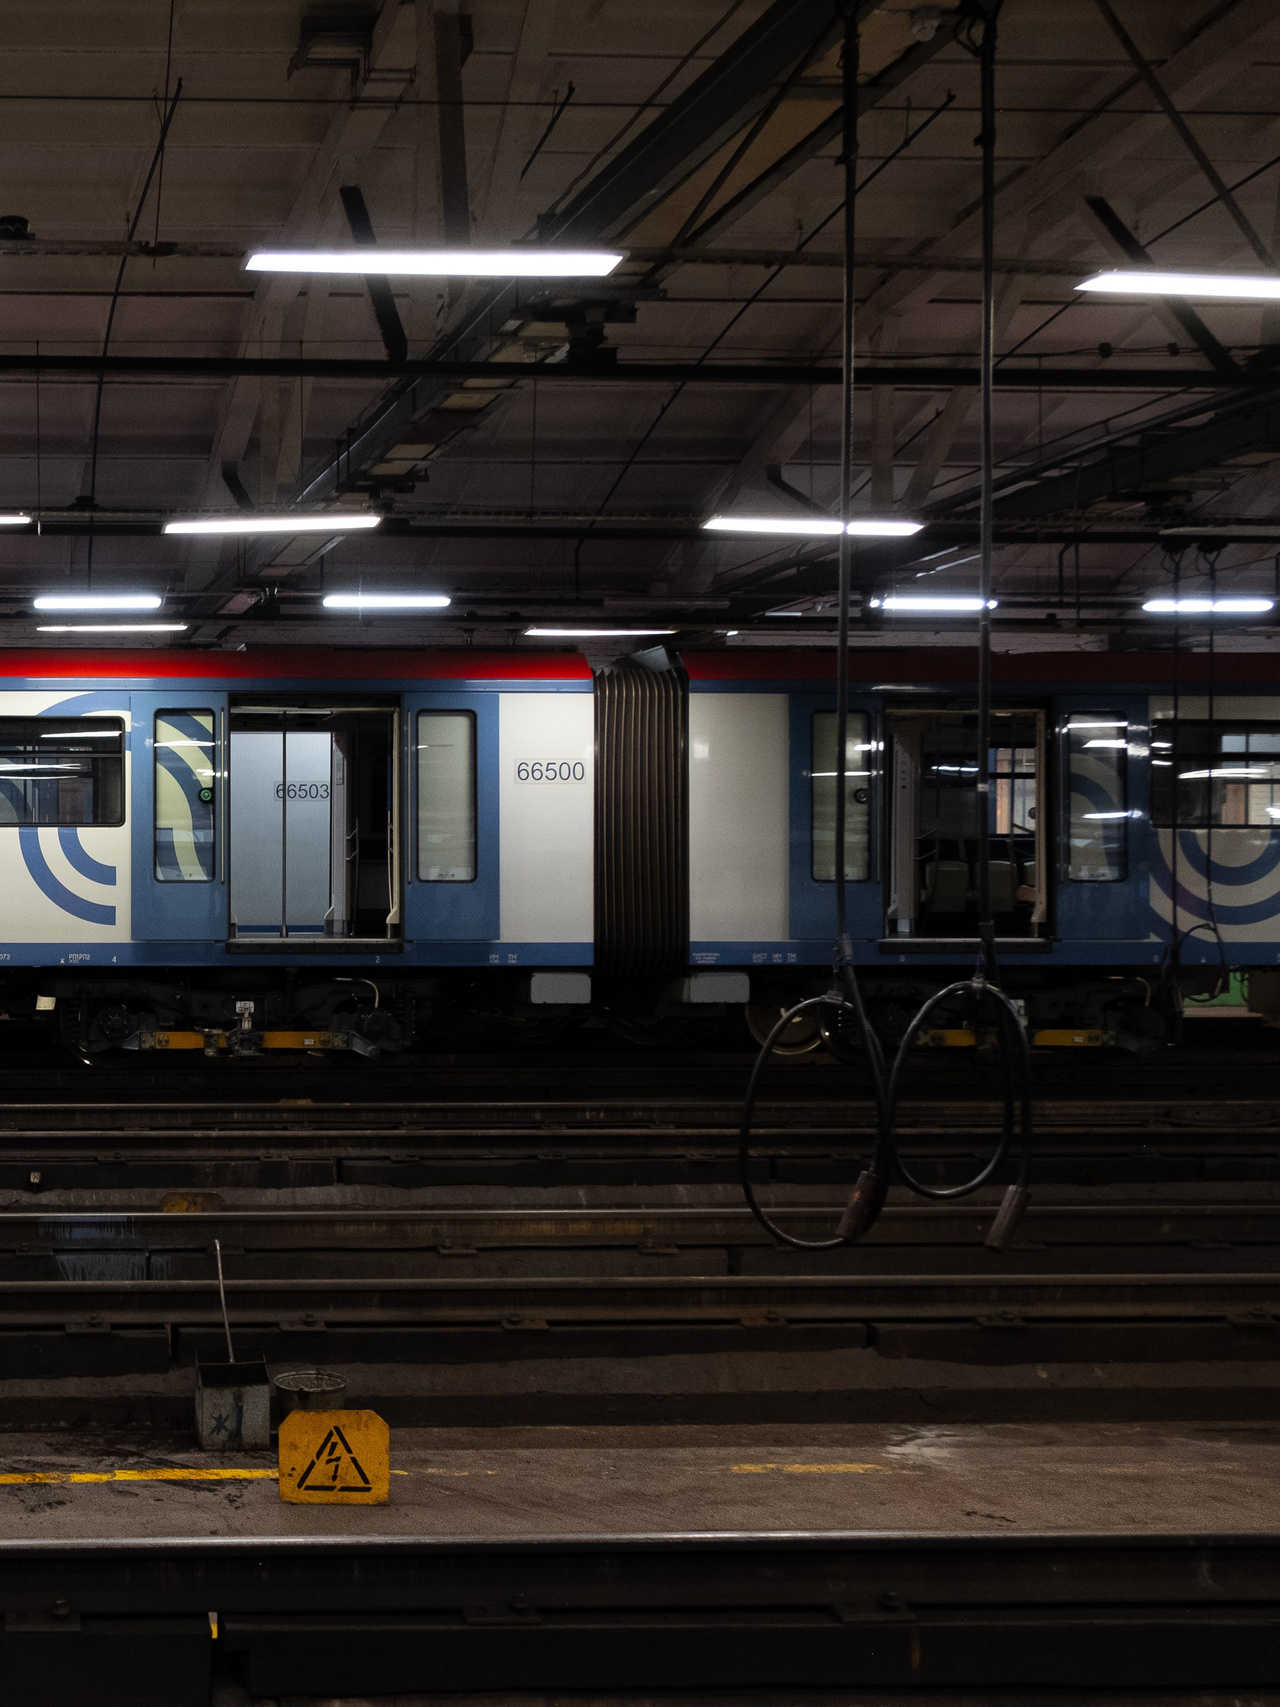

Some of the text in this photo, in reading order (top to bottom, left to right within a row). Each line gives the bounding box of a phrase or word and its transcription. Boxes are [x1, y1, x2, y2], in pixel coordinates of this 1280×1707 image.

[517, 762, 585, 781] 66500
[276, 783, 330, 799] 66503
[375, 956, 381, 964] 2
